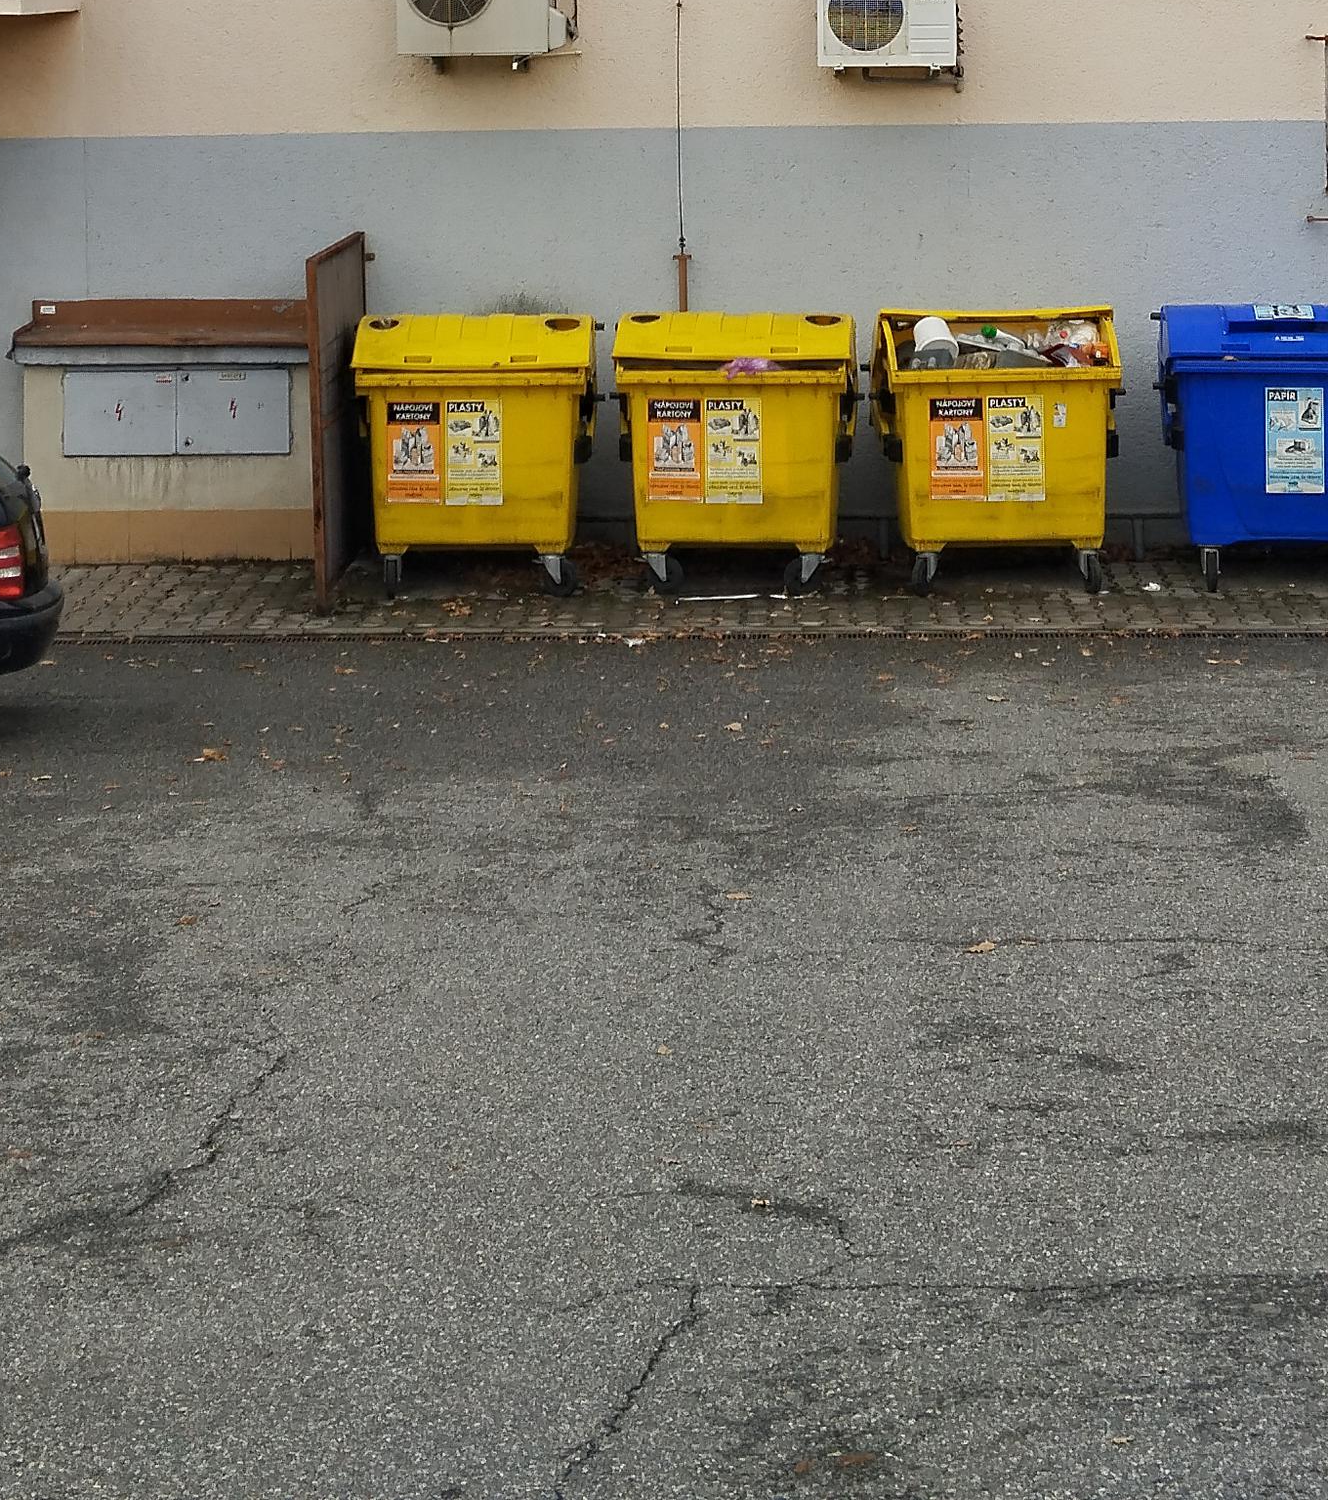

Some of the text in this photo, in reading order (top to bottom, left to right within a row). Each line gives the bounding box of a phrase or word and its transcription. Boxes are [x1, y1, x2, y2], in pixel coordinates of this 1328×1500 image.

[1269, 389, 1296, 401] PAPÍR
[708, 401, 743, 411] PLASTY
[989, 398, 1024, 407] PLASTY
[448, 403, 483, 412] PLASTY
[395, 412, 431, 421] KARTONY
[656, 410, 692, 419] KARTONY
[938, 408, 974, 417] KARTONY
